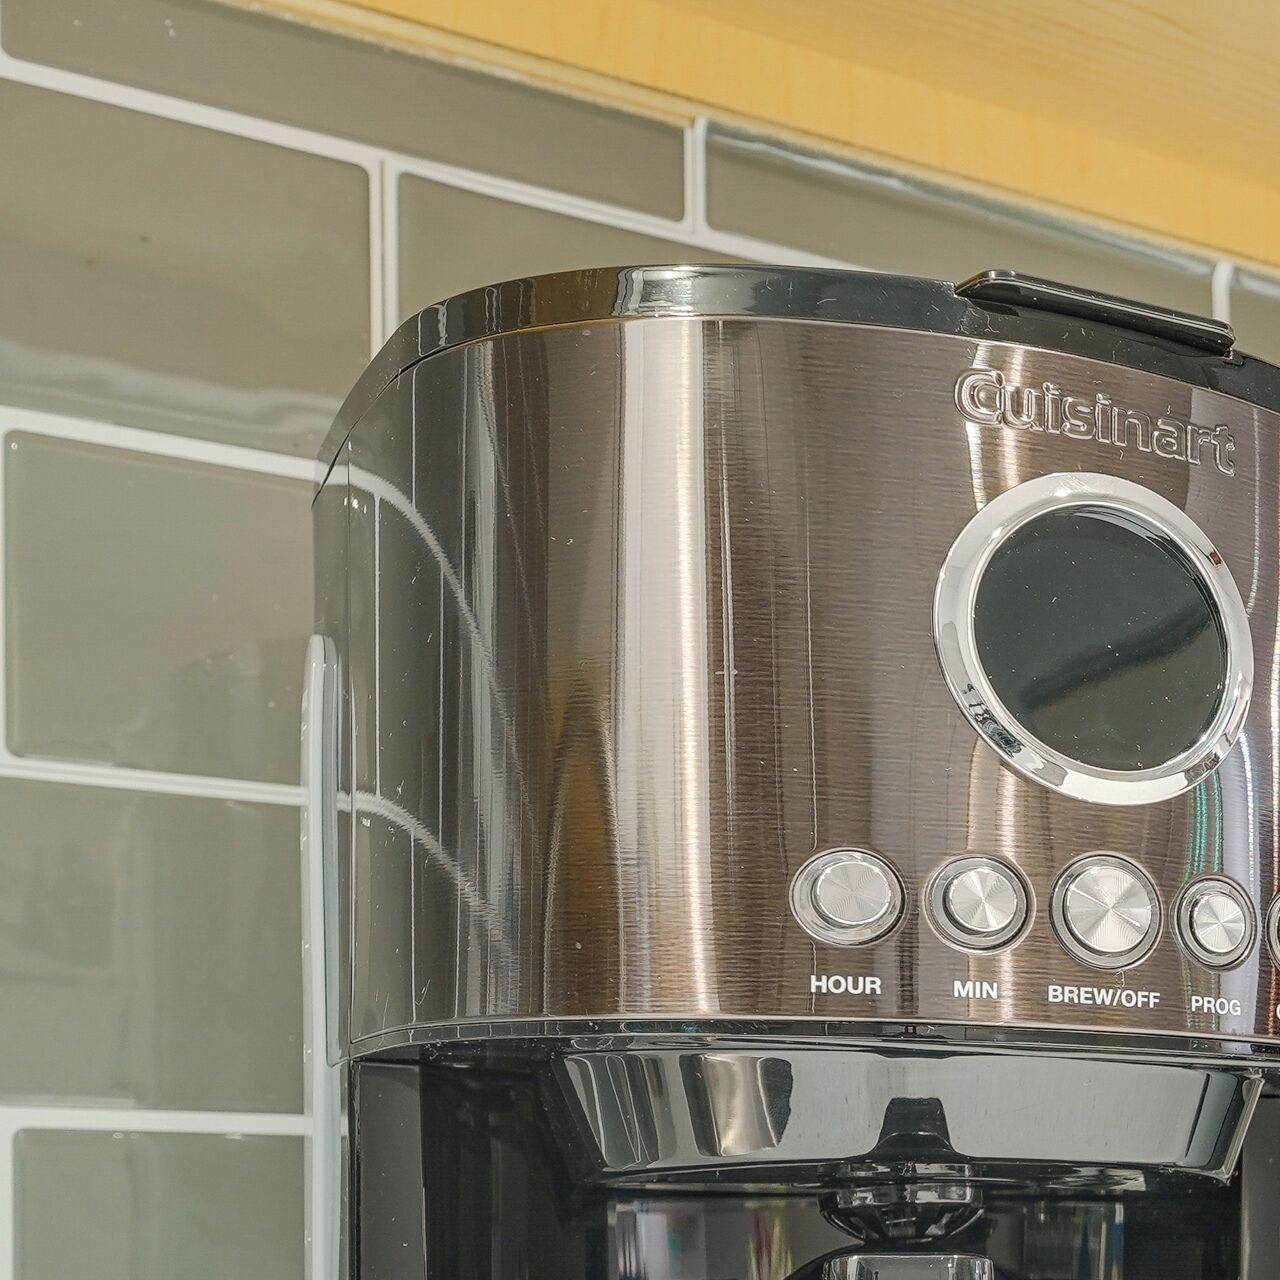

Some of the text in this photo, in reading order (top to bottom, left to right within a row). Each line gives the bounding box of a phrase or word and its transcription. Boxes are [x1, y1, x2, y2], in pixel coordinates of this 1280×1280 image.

[954, 368, 1236, 477] Cuisinart
[810, 975, 882, 995] HOUR
[952, 980, 999, 999] MIN
[1047, 985, 1161, 1009] BREW/OFF
[1191, 996, 1242, 1016] PROG
